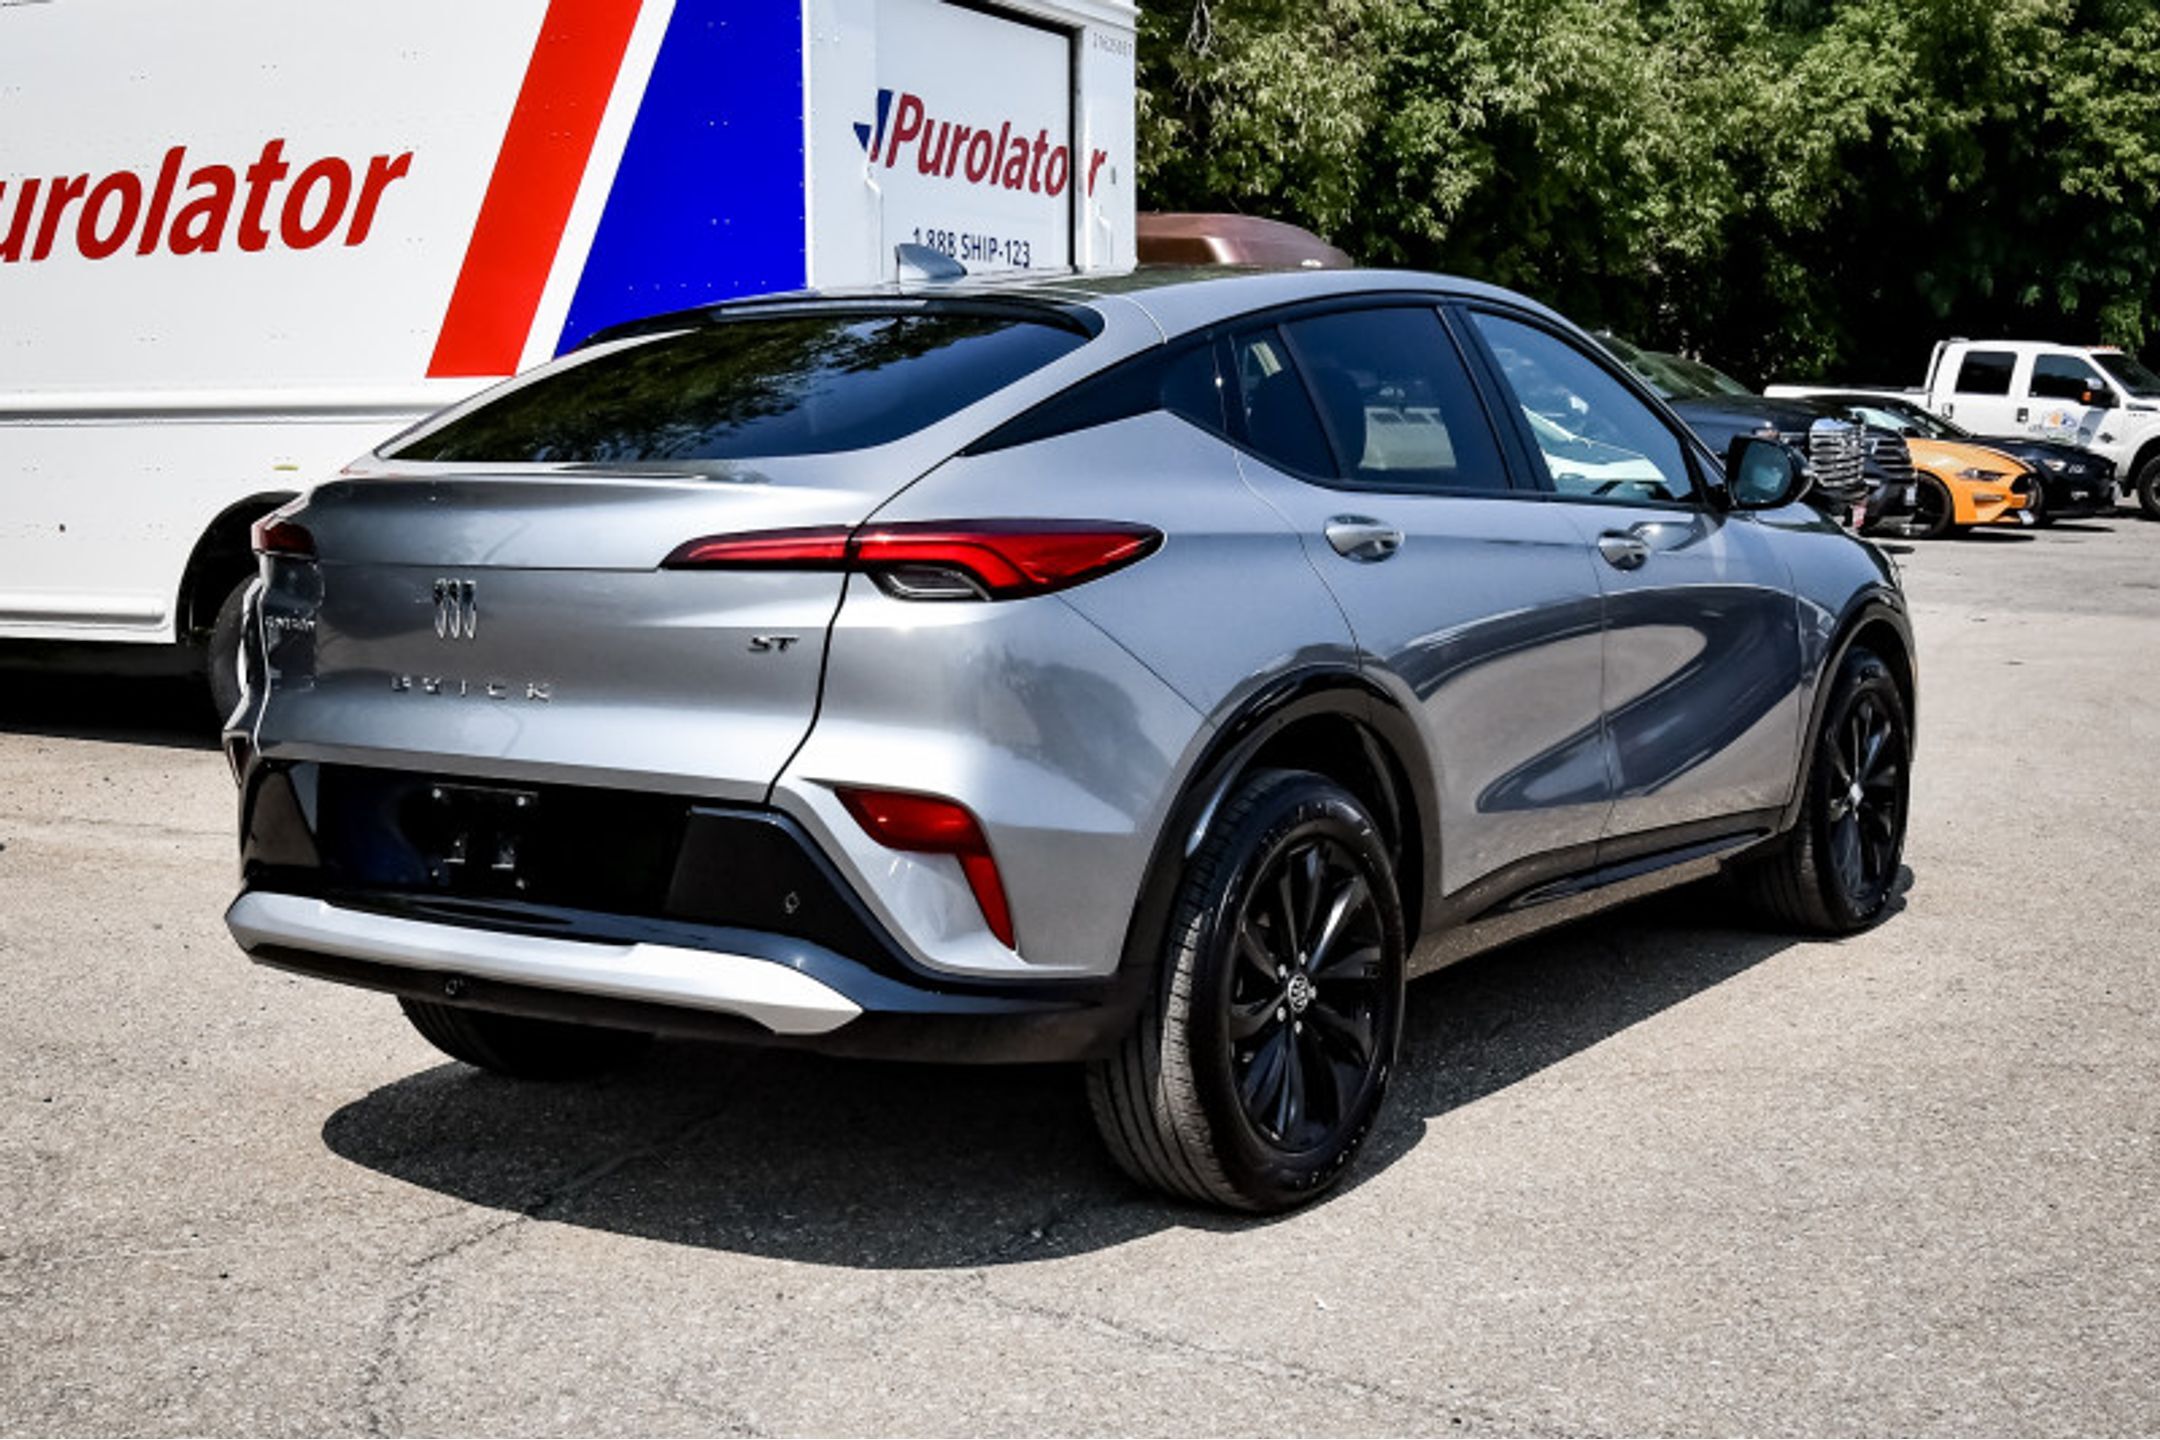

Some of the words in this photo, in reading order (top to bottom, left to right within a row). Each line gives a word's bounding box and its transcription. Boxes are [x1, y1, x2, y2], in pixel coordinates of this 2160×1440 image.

[886, 92, 1107, 197] Purolator
[961, 233, 1030, 268] SHIP-123
[748, 635, 799, 652] ST
[391, 674, 550, 702] BUICK
